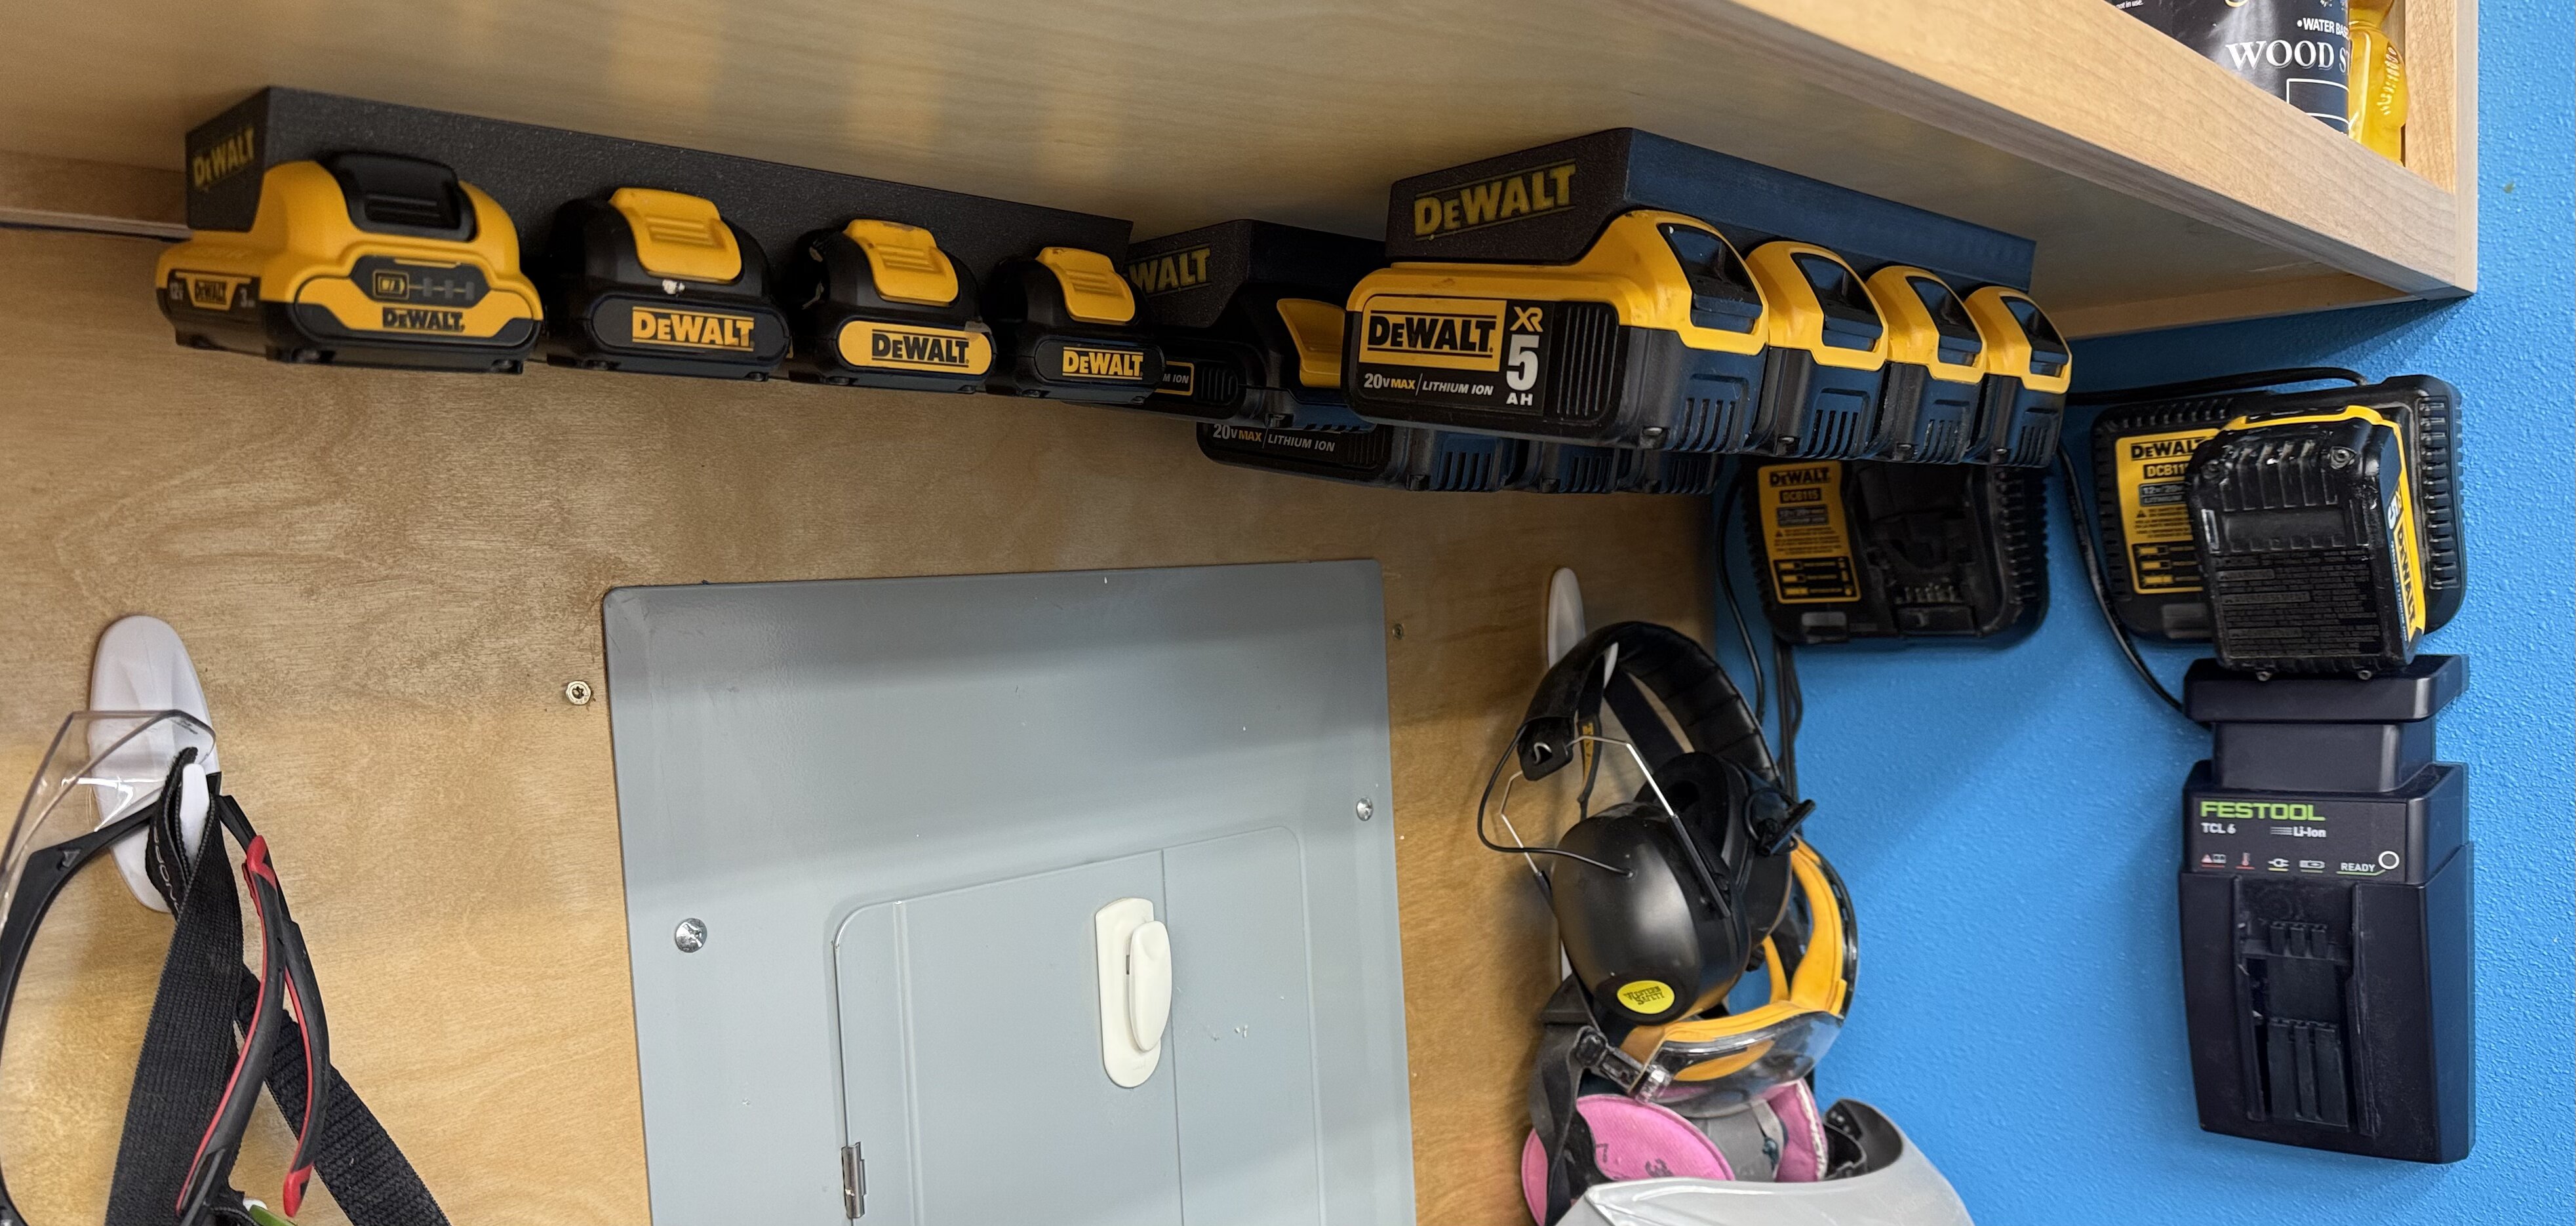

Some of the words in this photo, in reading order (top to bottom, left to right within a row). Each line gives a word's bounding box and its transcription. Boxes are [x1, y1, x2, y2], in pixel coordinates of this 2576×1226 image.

[2303, 18, 2335, 33] WATER
[2225, 39, 2335, 70] WOOD
[1414, 165, 1576, 236] DEWALT
[382, 307, 465, 332] DEWALT
[633, 311, 755, 347] DEWALT
[1510, 306, 1543, 332] XR
[1367, 315, 1497, 354] DEWALT
[872, 333, 970, 364] DEWALT
[1062, 349, 1144, 377] DEWALT
[1506, 334, 1539, 391] 5
[1172, 374, 1189, 384] ION
[1391, 378, 1416, 389] MAX
[1422, 380, 1469, 394] LITHIUM
[1471, 384, 1494, 395] ION
[1506, 392, 1534, 406] AH
[1238, 430, 1262, 442] MAX
[1268, 433, 1312, 449] LITHIUM
[1315, 440, 1336, 452] ION
[2147, 463, 2189, 477] DCB11
[2201, 801, 2326, 821] FESTOOL
[2201, 822, 2226, 834] TCL
[2228, 823, 2236, 834] 6
[2293, 827, 2326, 838] Li-Ion
[2341, 862, 2375, 872] READY
